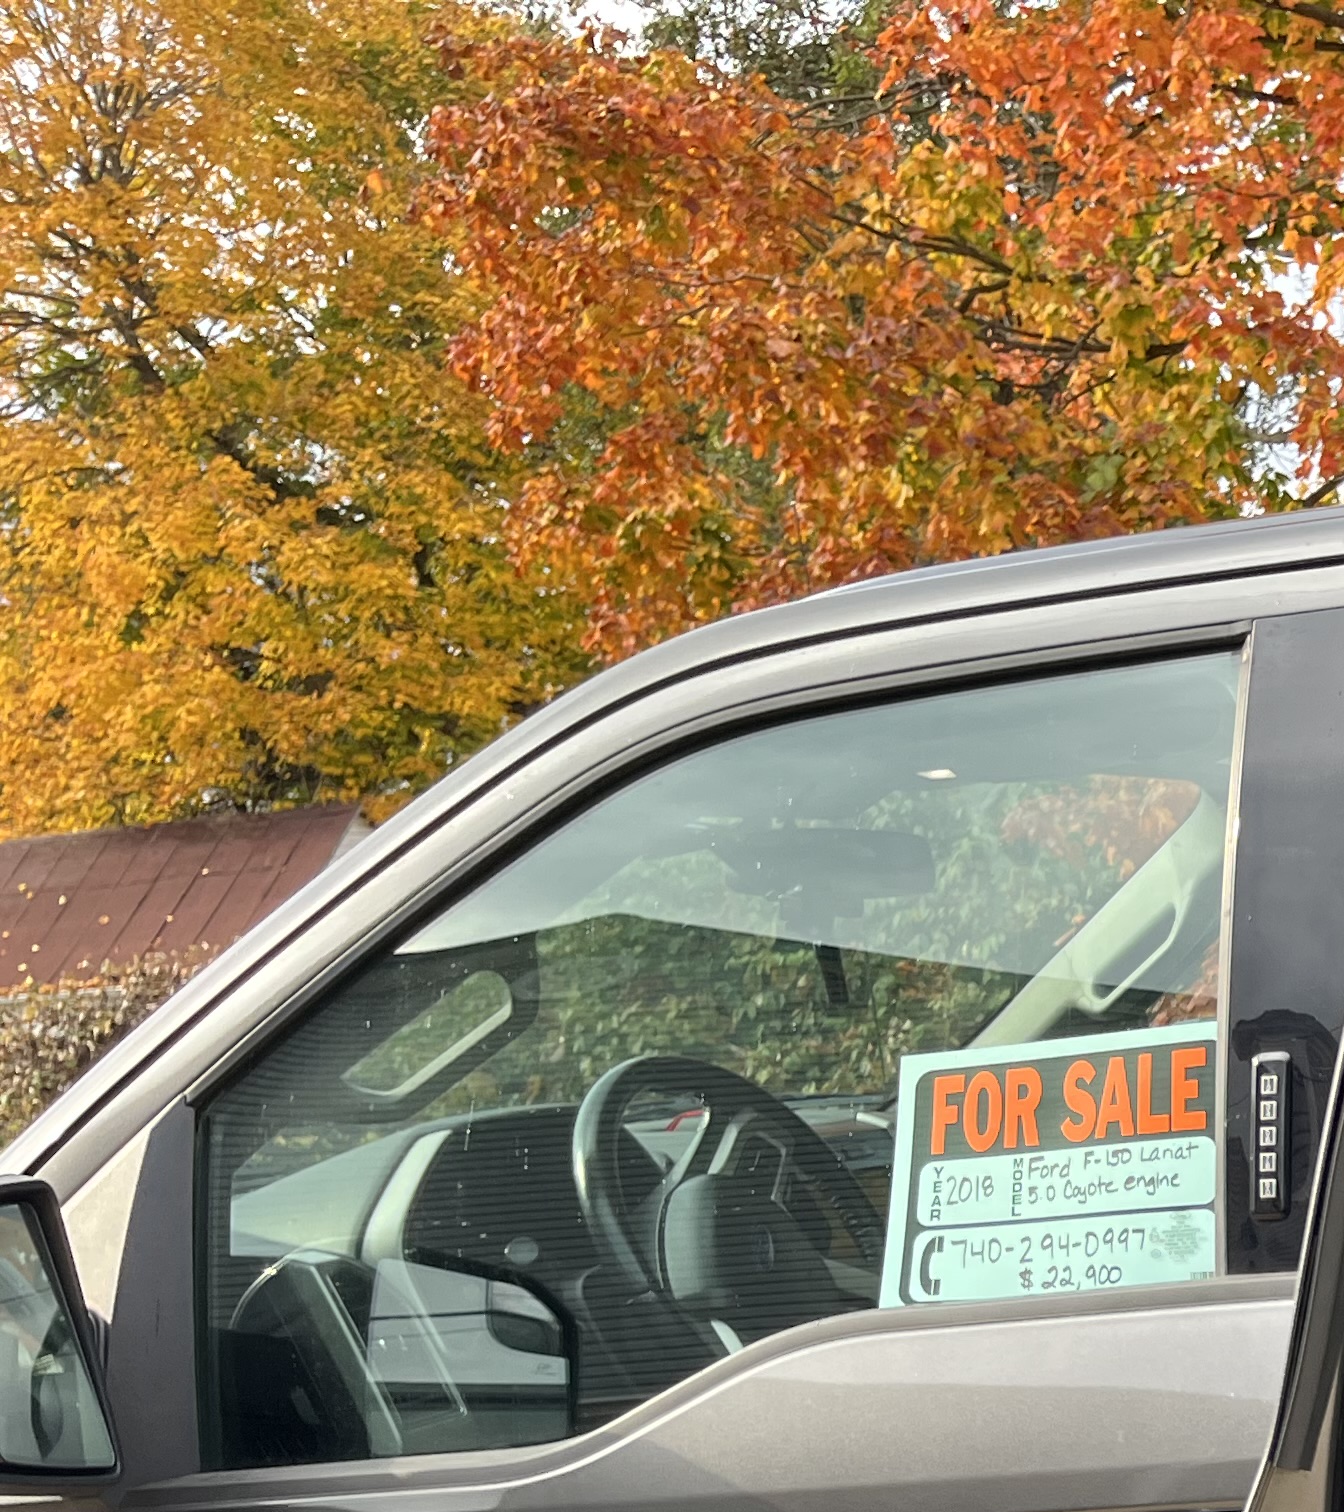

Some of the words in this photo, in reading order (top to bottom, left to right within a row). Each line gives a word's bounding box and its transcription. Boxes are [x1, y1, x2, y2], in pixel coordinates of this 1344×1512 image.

[930, 1066, 1043, 1155] FOR
[1061, 1047, 1207, 1142] SALE
[1028, 1155, 1072, 1180] Ford
[1083, 1148, 1132, 1170] F-150
[930, 1166, 944, 1221] YEAR
[946, 1175, 995, 1205] 2018
[1011, 1158, 1024, 1217] MODEL
[1028, 1184, 1056, 1204] 5.0
[1063, 1176, 1119, 1204] Coyote
[1123, 1172, 1181, 1196] engine
[951, 1227, 1146, 1269] 740-294-0997
